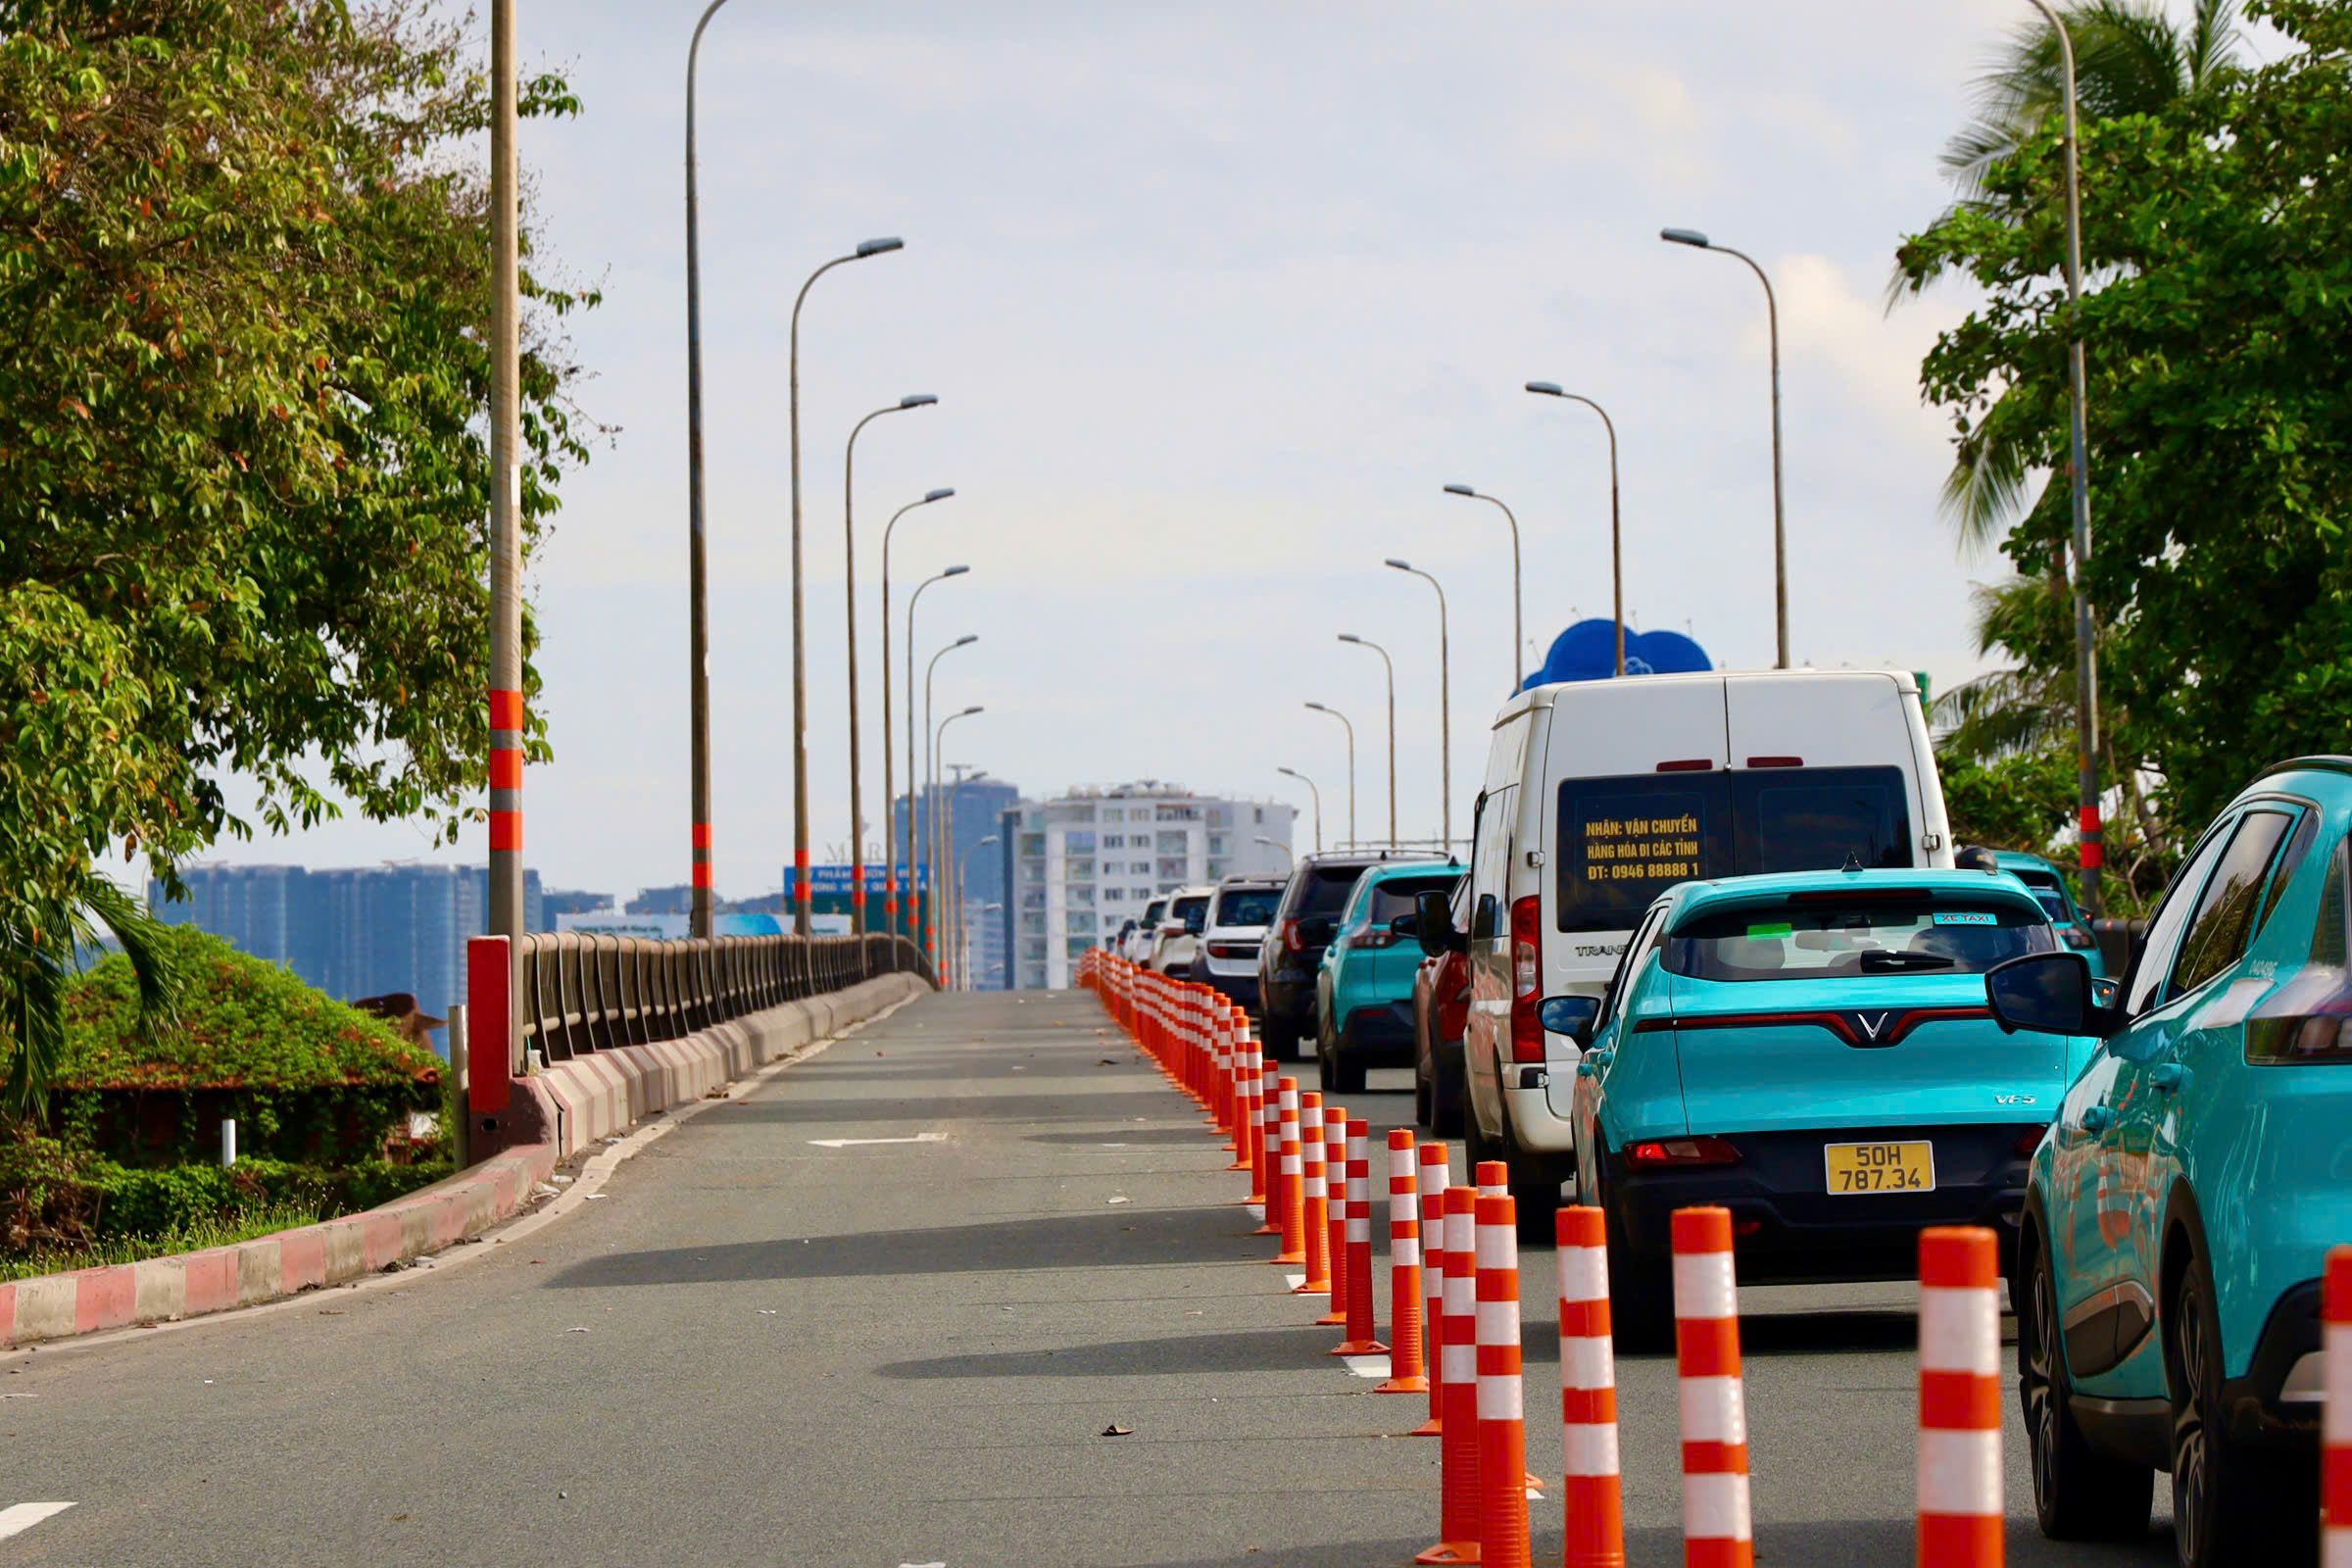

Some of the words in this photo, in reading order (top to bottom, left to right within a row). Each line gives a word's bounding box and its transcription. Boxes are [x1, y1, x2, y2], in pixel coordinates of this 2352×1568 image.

[1586, 818, 1623, 839] NHẬN:
[1625, 817, 1648, 838] VẬN
[1651, 812, 1697, 834] CHUYỂN
[1588, 842, 1615, 859] HÀNG
[1617, 840, 1638, 858] HÓA
[1652, 839, 1672, 857] CÁC
[1675, 838, 1698, 856] TỈNH
[1611, 863, 1644, 879] 0946
[1647, 862, 1688, 878] 88888
[1691, 862, 1698, 876] 1
[1942, 913, 1958, 922] XE
[1856, 1145, 1901, 1166] 50H
[1838, 1168, 1921, 1191] 787.34
